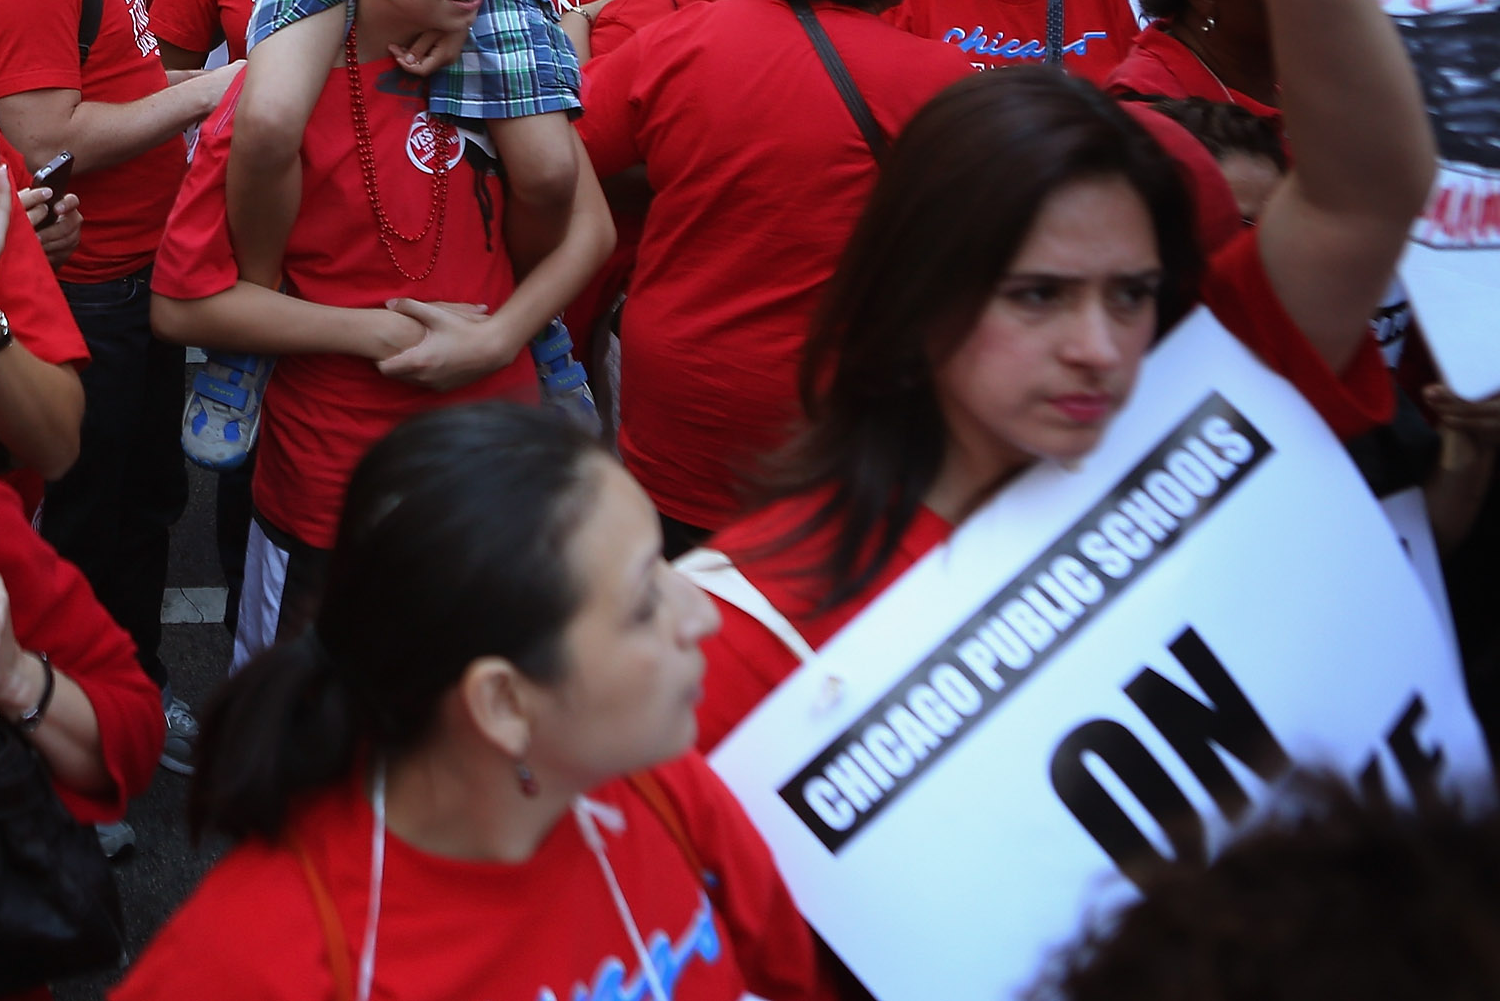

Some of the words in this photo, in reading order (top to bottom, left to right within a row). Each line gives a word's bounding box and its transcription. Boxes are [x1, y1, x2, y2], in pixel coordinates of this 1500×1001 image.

[943, 26, 1108, 59] Chicao
[410, 128, 435, 150] YES
[802, 671, 984, 834] CHICAGO
[958, 555, 1104, 694] PUBLIC
[1083, 417, 1254, 582] SCHOOLS
[1046, 624, 1295, 901] ON
